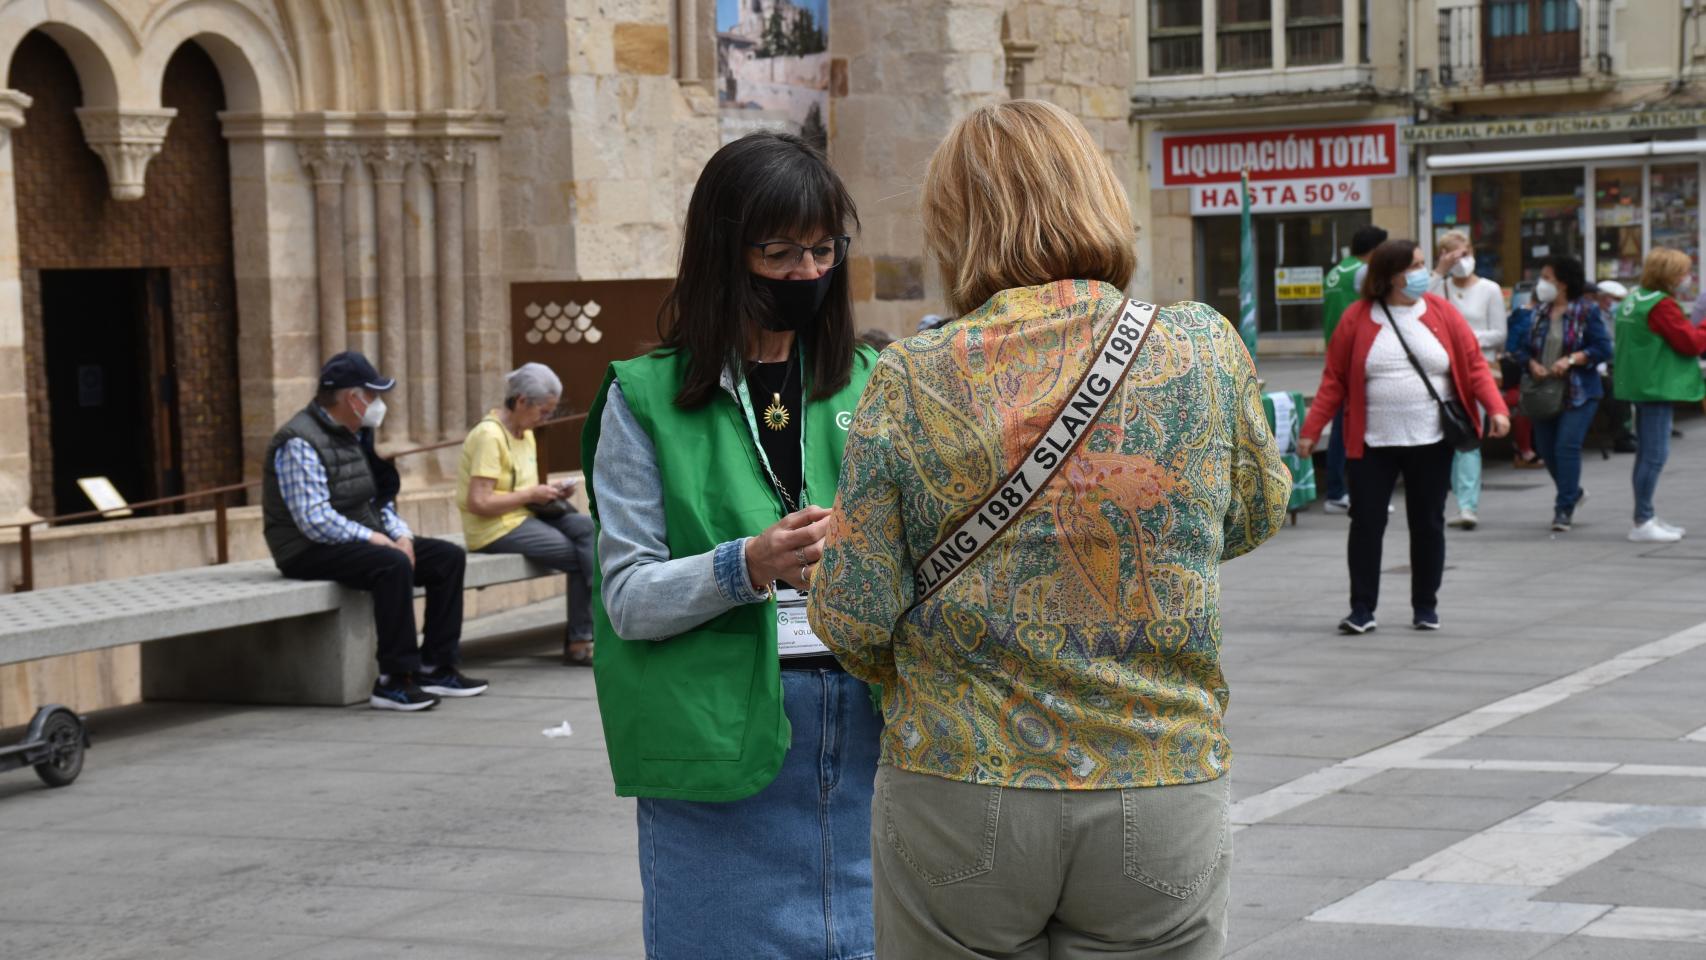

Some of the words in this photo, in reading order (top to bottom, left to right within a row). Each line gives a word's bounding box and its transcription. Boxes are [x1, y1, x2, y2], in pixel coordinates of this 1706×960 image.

[1403, 126, 1480, 140] MATERIAL
[1486, 122, 1528, 135] PARA
[1534, 117, 1611, 134] OFICINAS
[1171, 134, 1315, 177] LIQUIDACIÓN
[1319, 134, 1389, 167] TOTAL
[1201, 184, 1297, 208] HASTA
[1304, 182, 1361, 203] 50%
[917, 530, 978, 597] SLANG
[978, 472, 1034, 531] 1987
[1034, 373, 1111, 470] SLANG
[1104, 311, 1145, 367] 1987
